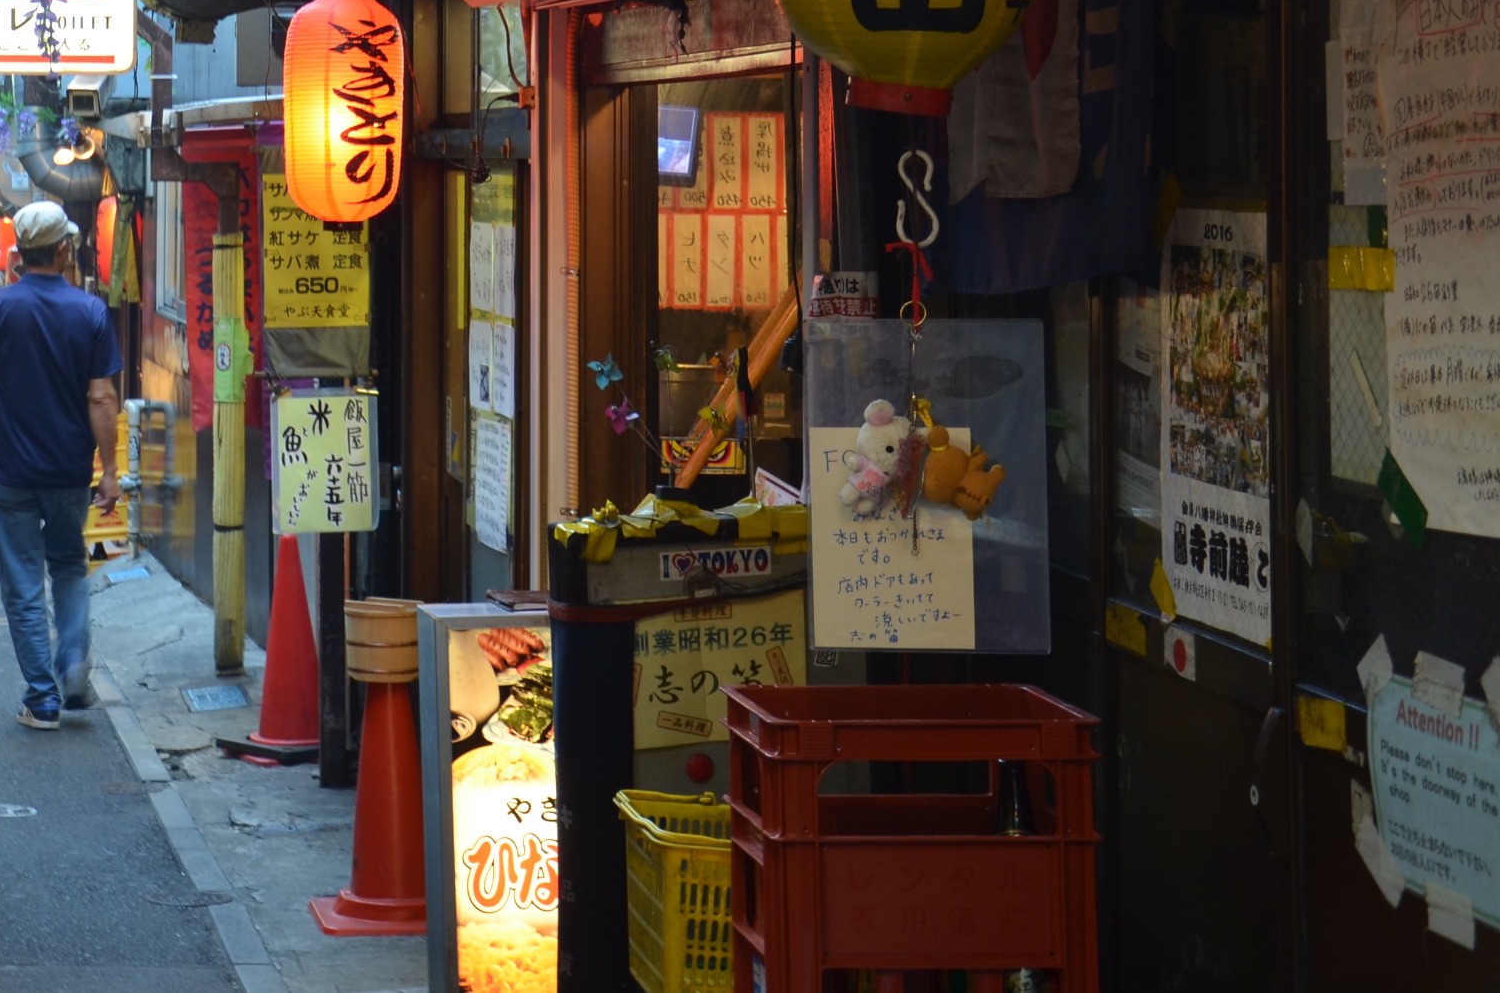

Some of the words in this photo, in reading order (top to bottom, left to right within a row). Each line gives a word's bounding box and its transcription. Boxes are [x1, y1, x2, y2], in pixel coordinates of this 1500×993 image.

[330, 19, 399, 205] やきとり
[269, 230, 320, 246] 紅サケ
[332, 229, 363, 245] 定食
[1203, 222, 1233, 241] 2016
[269, 254, 320, 270] サバ煮
[332, 253, 363, 270] 定食
[295, 277, 339, 294] 650
[698, 548, 768, 575] TOKYO
[661, 716, 707, 732] 一品料理
[1396, 699, 1463, 747] Attention
[1380, 739, 1410, 763] Please
[1414, 754, 1441, 774] don't
[1446, 766, 1467, 784] stop
[1473, 772, 1498, 796] here.
[1402, 767, 1416, 785] the
[1421, 775, 1461, 804] doorway
[1466, 793, 1477, 808] of
[1482, 800, 1498, 818] the
